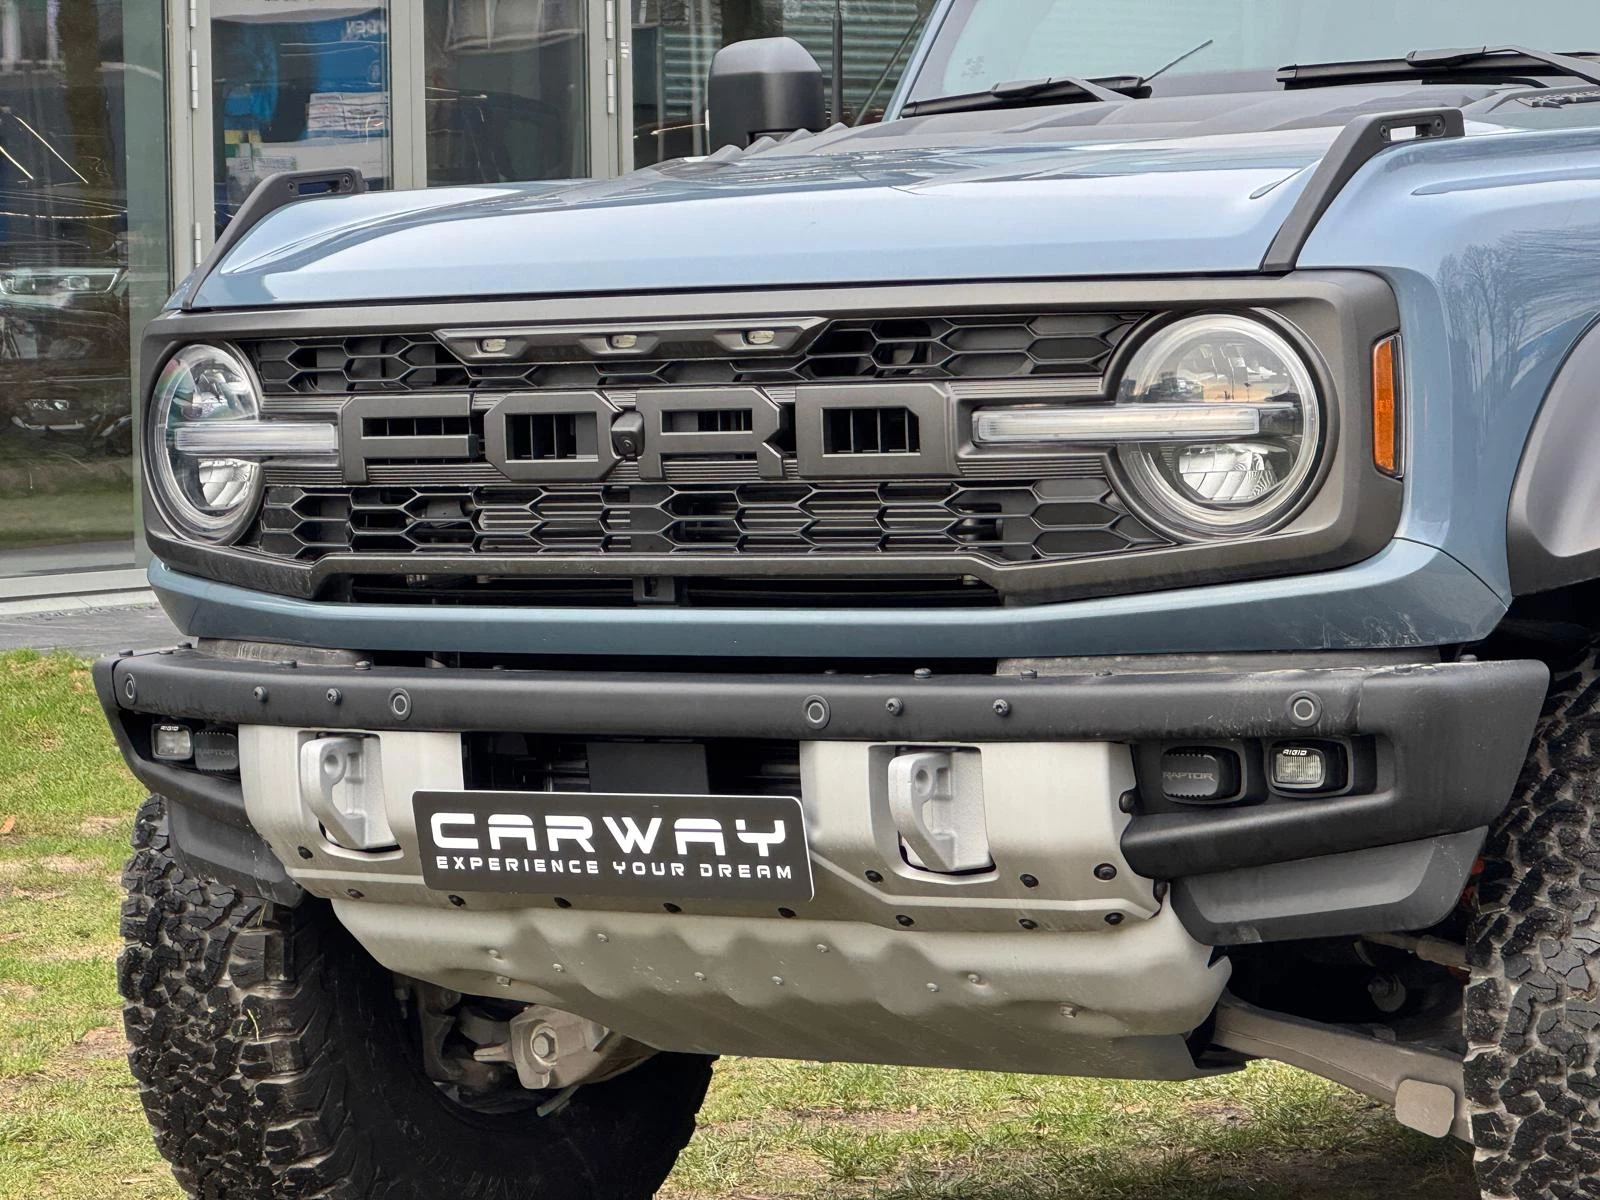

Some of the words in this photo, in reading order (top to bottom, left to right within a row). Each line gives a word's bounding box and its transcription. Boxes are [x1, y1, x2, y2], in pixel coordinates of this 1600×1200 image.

[342, 384, 959, 485] FORD
[1162, 771, 1217, 782] RAPTOR
[430, 812, 786, 857] CARWAY
[435, 855, 599, 874] EXPERIENCE
[612, 861, 685, 877] YOUR
[699, 863, 792, 879] DREAM
